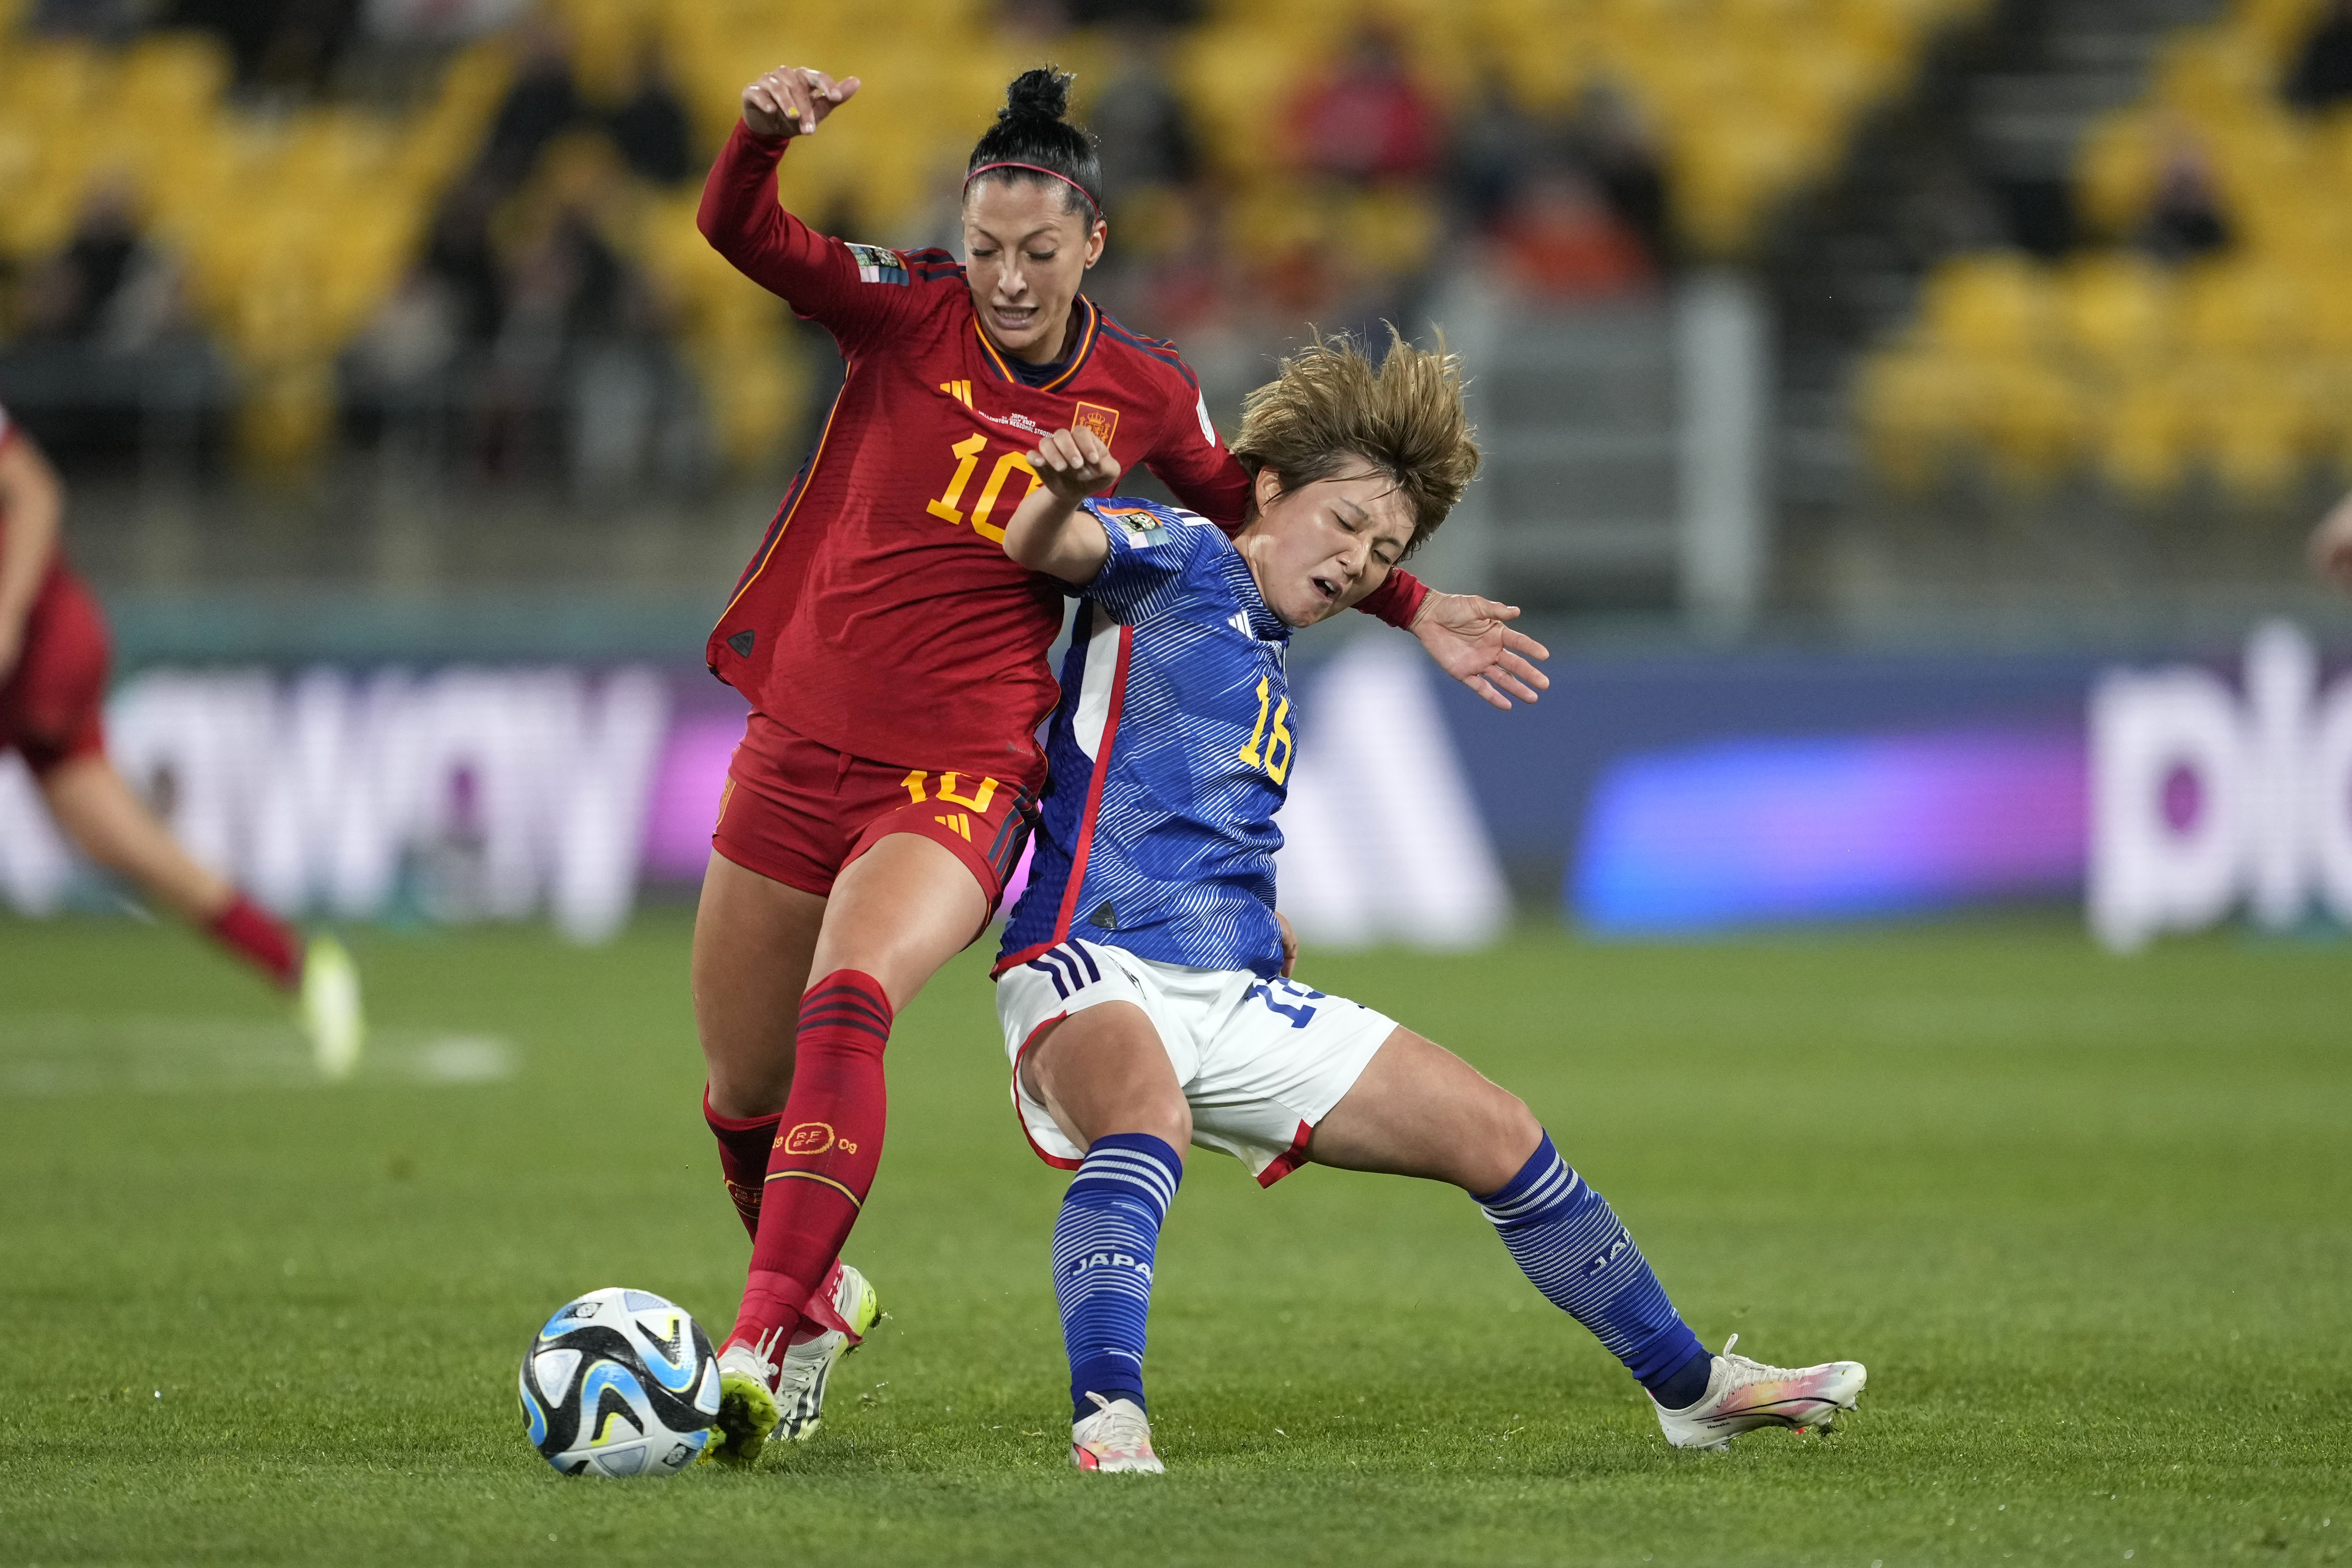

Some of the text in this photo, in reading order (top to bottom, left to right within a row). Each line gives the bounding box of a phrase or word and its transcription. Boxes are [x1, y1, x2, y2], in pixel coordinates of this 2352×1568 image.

[1010, 421, 1033, 433] REGIONAL
[926, 432, 1045, 545] 10
[1238, 674, 1293, 786] 16
[896, 769, 999, 813] 10
